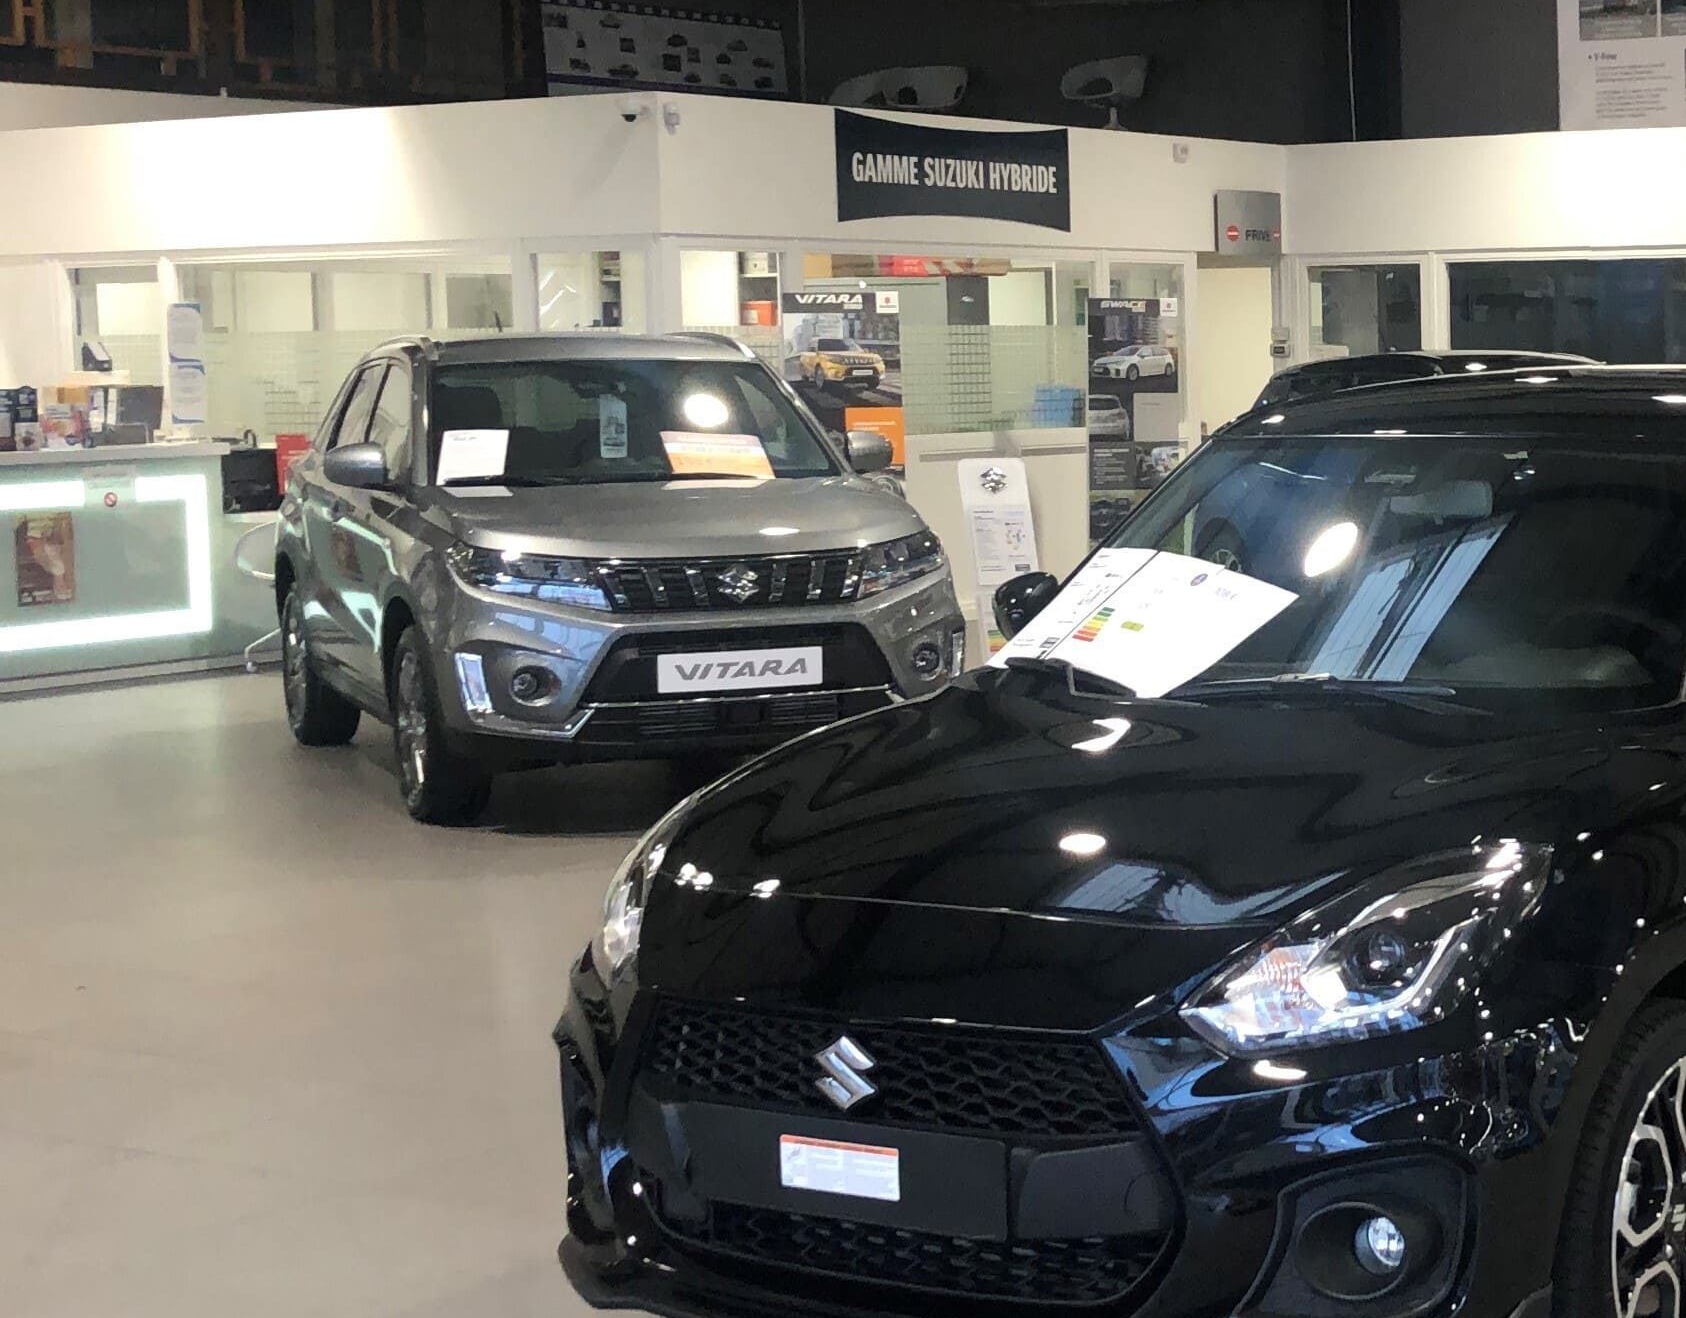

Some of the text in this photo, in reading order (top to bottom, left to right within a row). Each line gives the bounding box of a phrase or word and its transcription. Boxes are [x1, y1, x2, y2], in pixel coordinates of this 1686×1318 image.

[851, 152, 1058, 194] GAMME SUZUKI HYBRIDE
[794, 294, 863, 304] VITARA
[674, 657, 808, 681] VITARA
